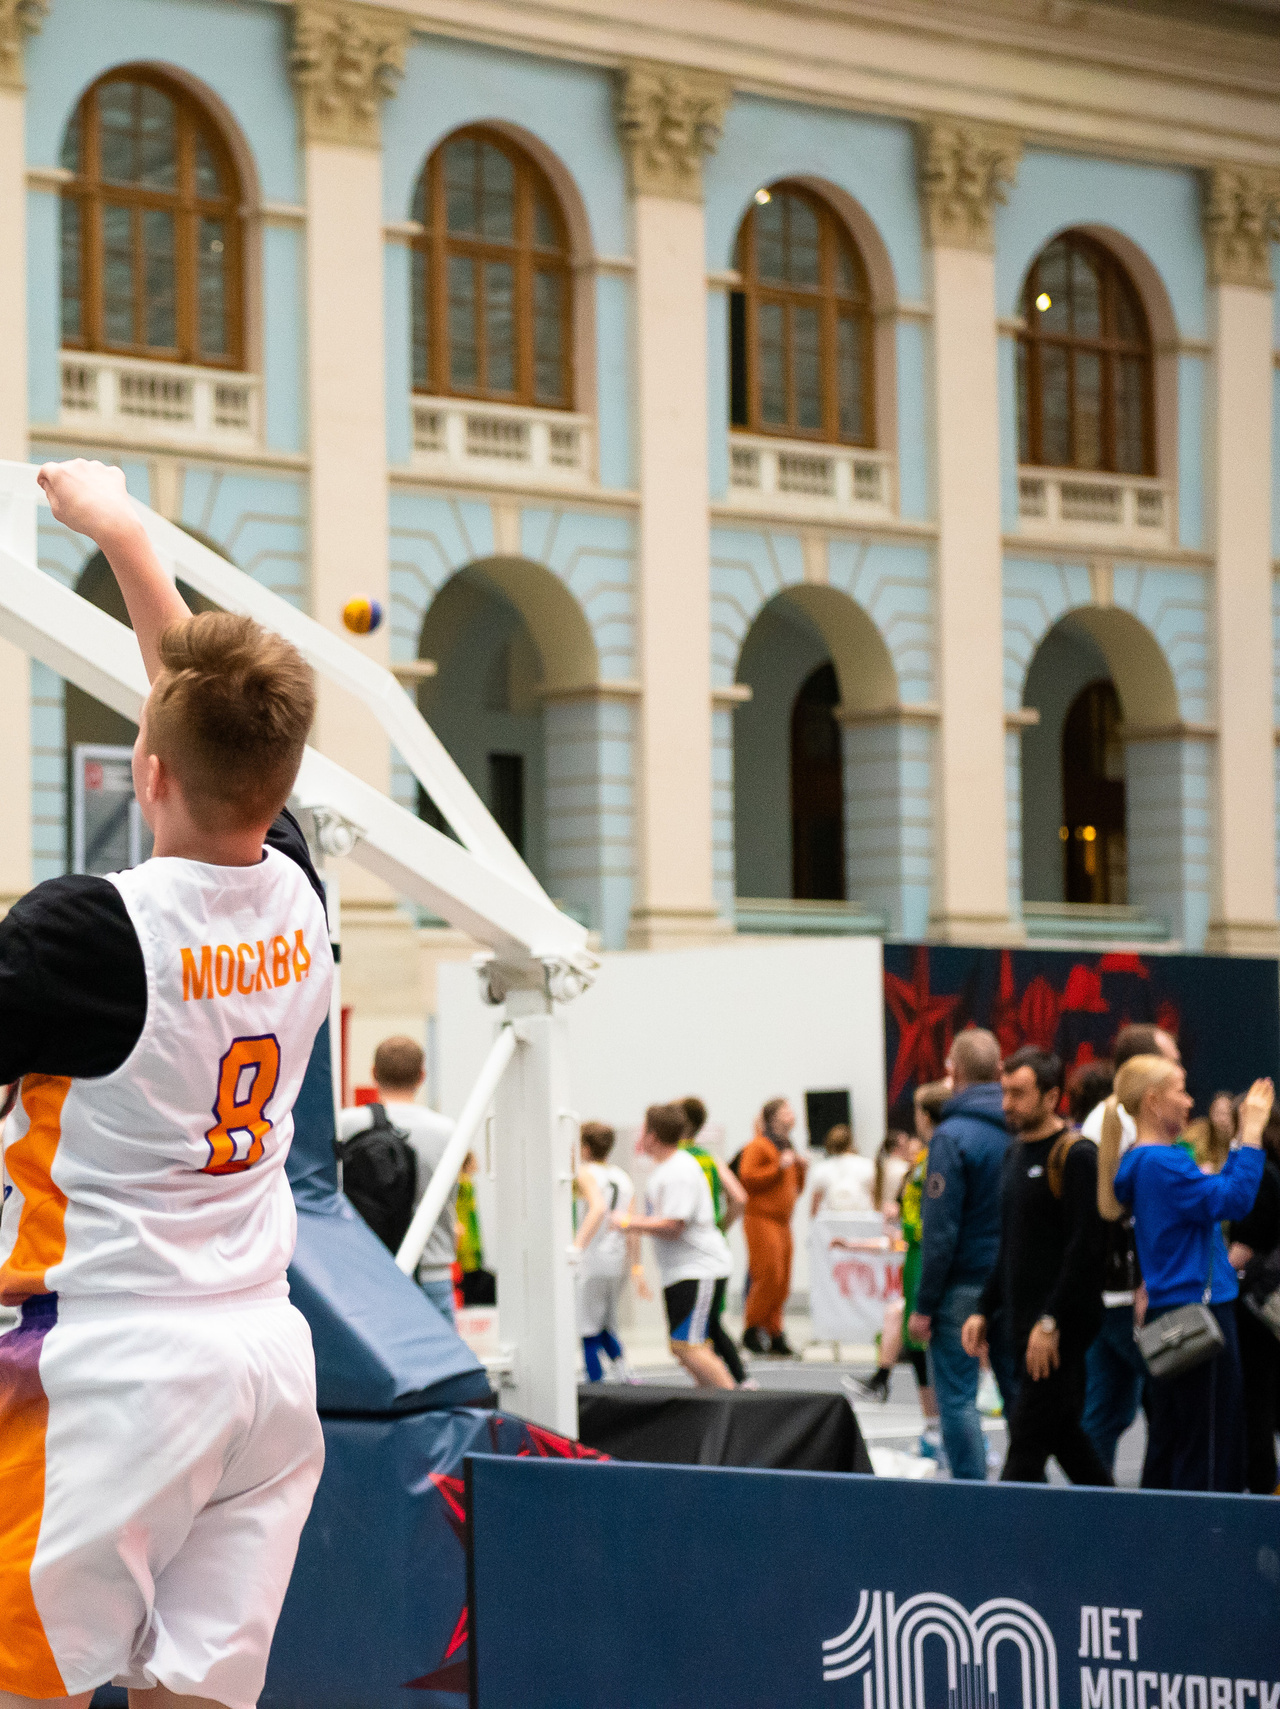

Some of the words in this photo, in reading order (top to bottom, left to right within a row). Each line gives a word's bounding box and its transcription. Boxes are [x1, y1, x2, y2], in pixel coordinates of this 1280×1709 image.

[180, 929, 311, 1001] МОСКВА
[200, 1033, 281, 1176] 8
[1078, 1605, 1143, 1662] ЛЕТ
